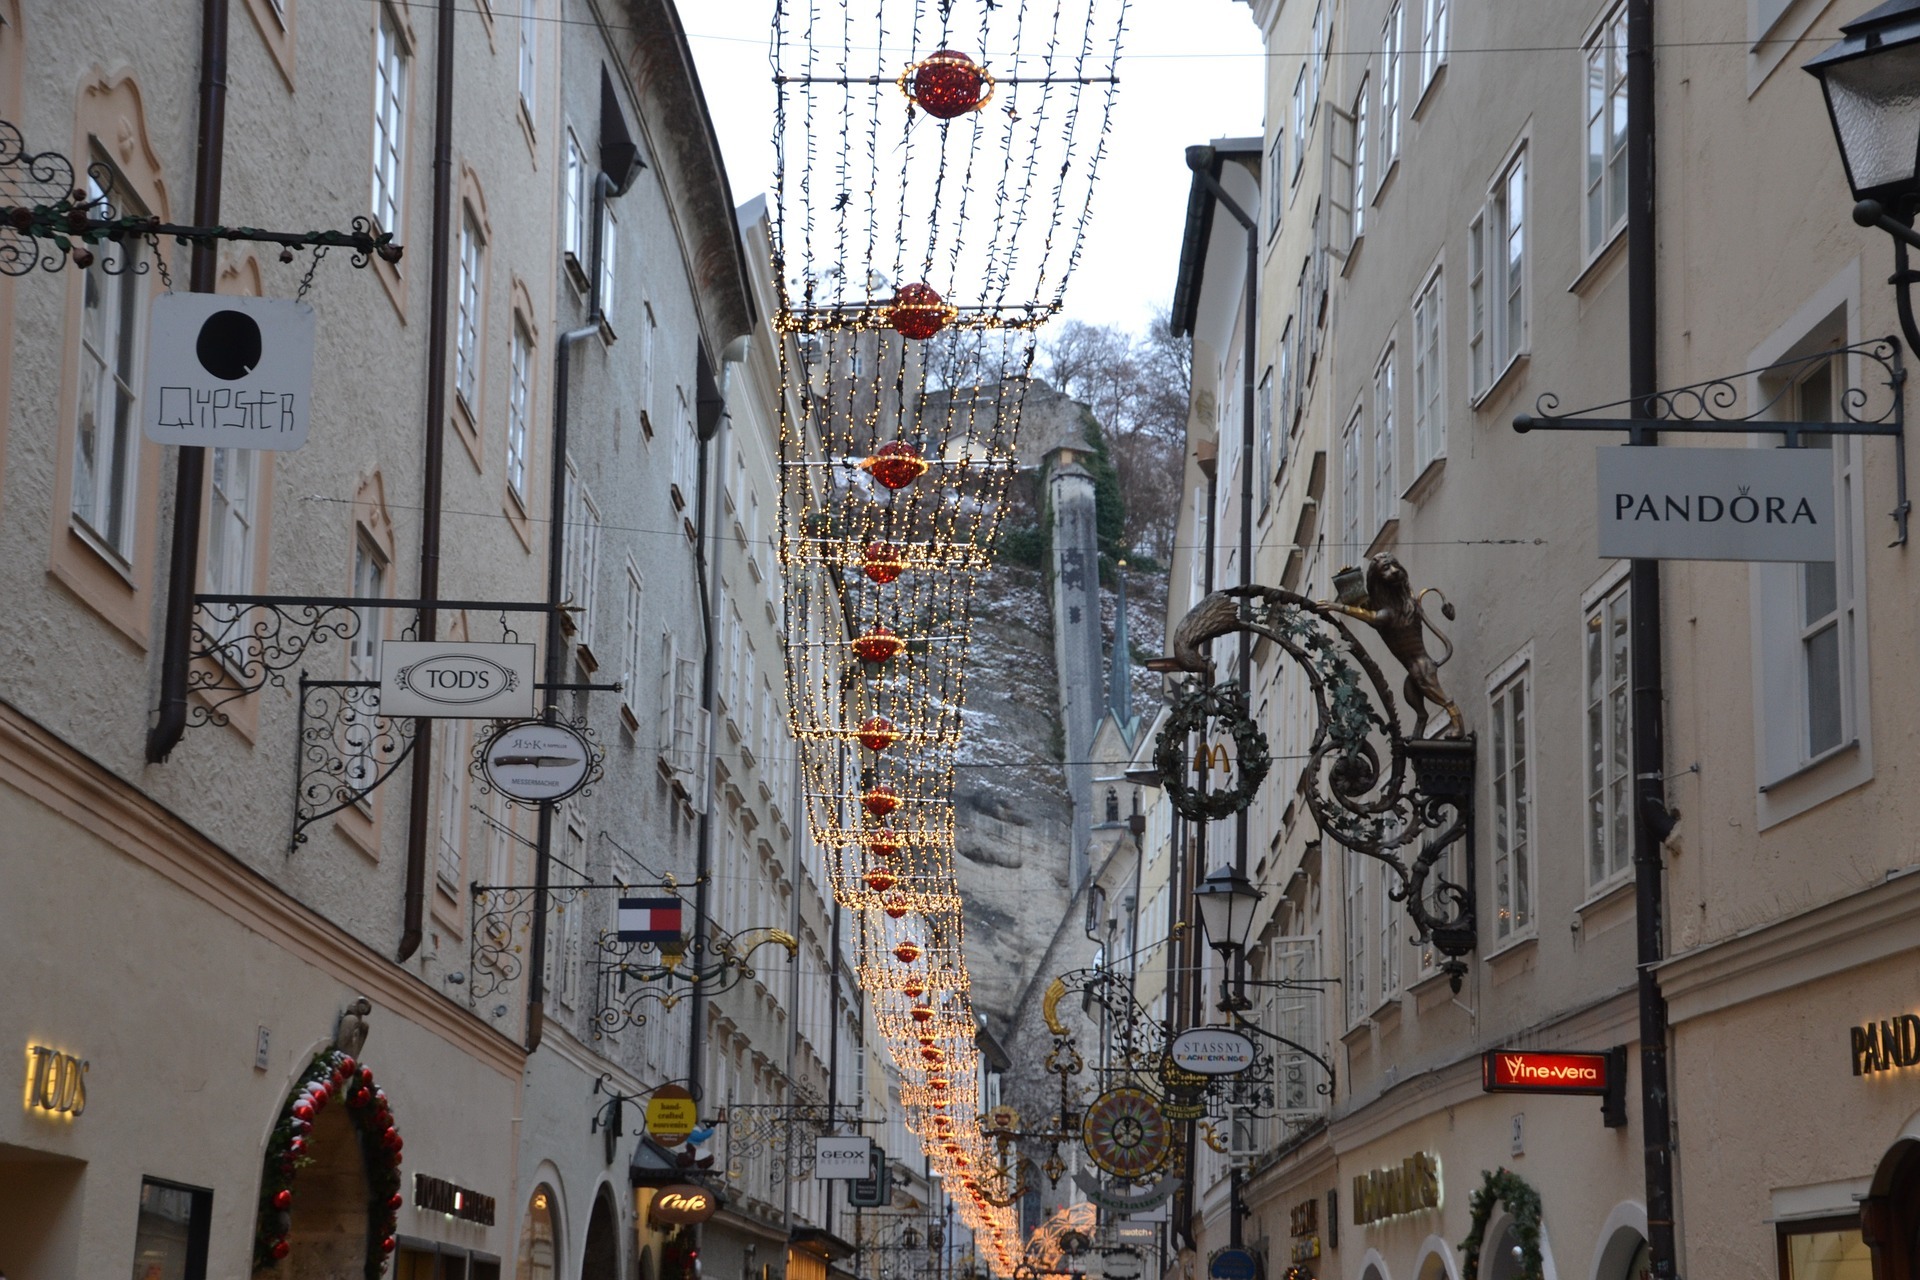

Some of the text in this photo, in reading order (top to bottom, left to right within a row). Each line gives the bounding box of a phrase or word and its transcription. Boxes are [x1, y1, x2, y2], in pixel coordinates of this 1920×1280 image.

[158, 386, 294, 433] QYPSTER
[1615, 489, 1818, 525] PANDORA
[426, 669, 489, 689] TOD'S
[511, 778, 560, 787] MESSERMACHER
[1183, 1042, 1242, 1054] STASSNY
[661, 1102, 682, 1110] hand-
[657, 1111, 684, 1119] crafted
[821, 1150, 865, 1159] GEOX
[1089, 1191, 1165, 1211] Aschauer
